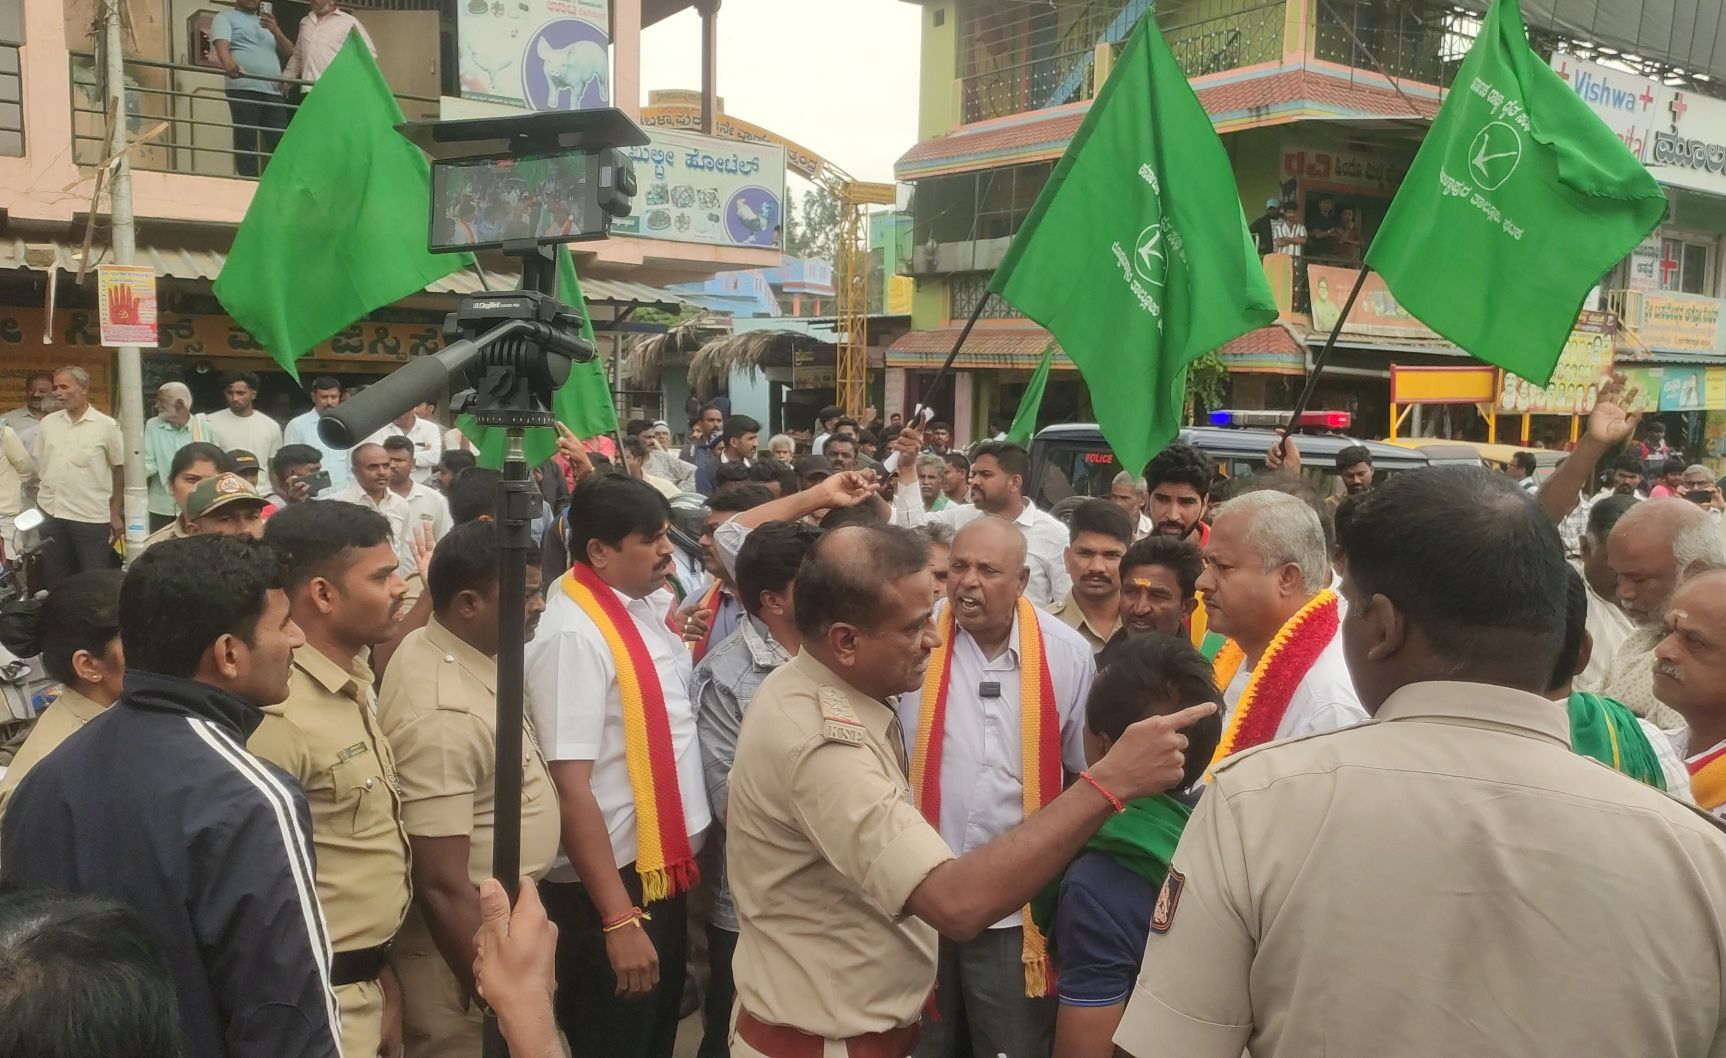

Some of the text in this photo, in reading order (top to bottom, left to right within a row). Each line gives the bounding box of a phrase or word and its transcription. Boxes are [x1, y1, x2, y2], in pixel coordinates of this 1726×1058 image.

[1575, 69, 1637, 112] Vishwa
[685, 148, 760, 176] ಹೋಟೆಲ್
[1085, 453, 1114, 464] POLICE
[828, 725, 864, 742] KSP
